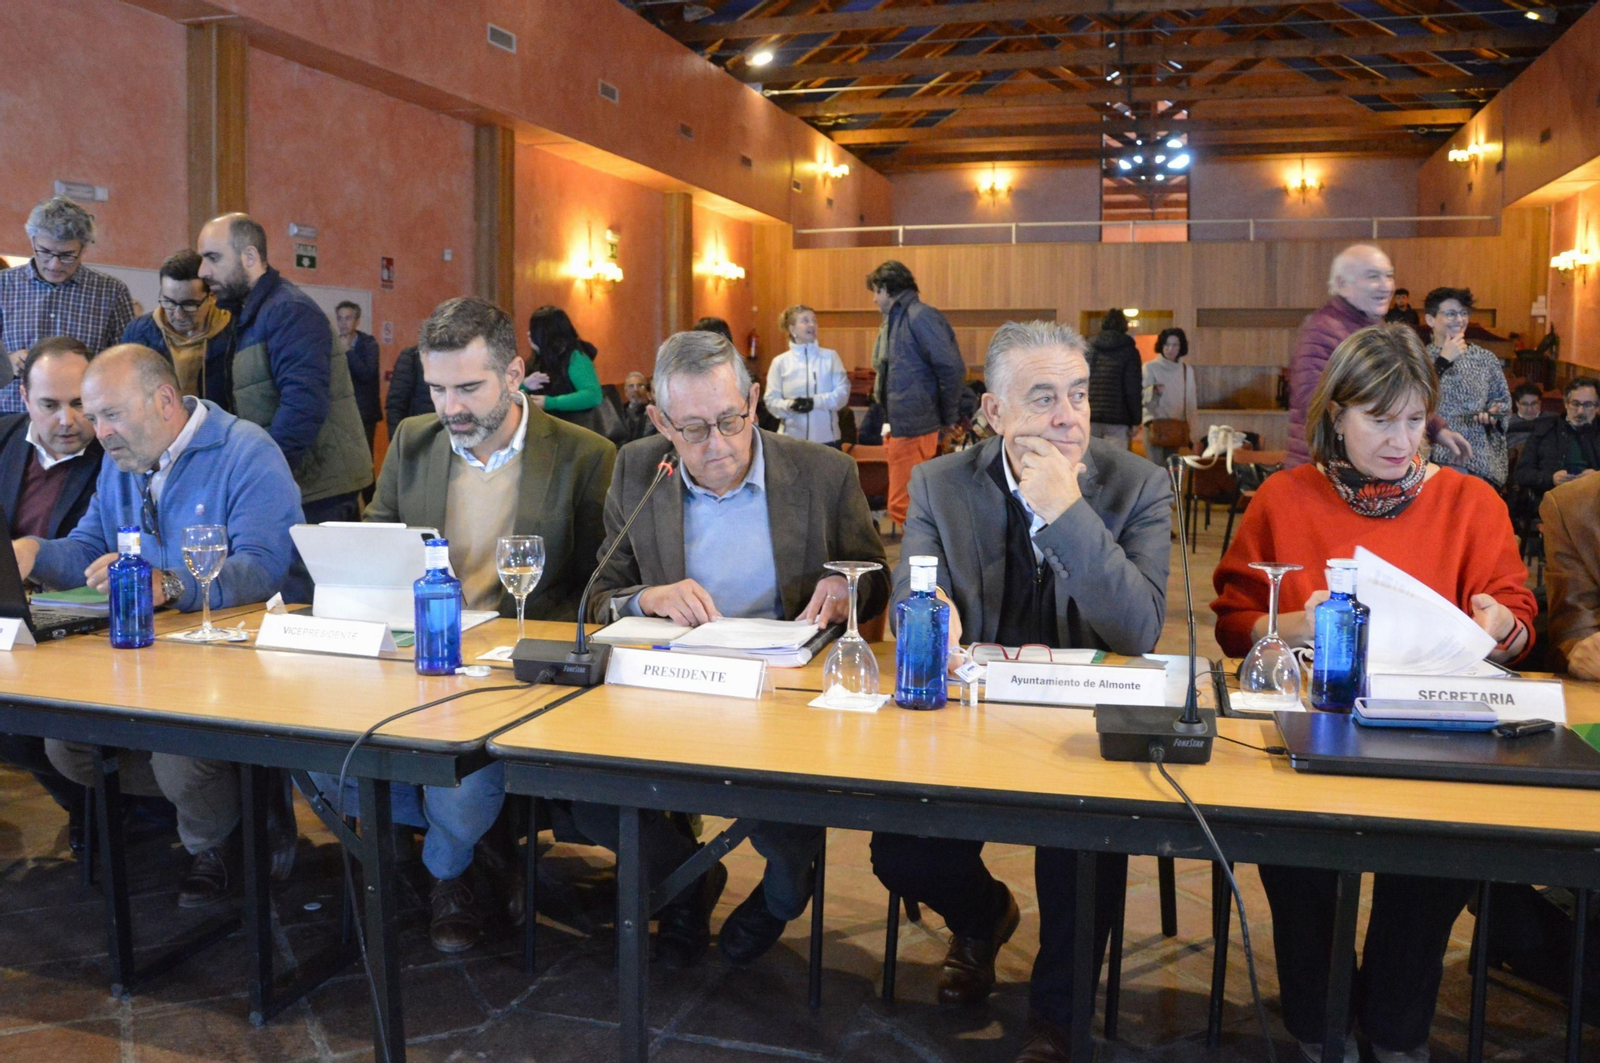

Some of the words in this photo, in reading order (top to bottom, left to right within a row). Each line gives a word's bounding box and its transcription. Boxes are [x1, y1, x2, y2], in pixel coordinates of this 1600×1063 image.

[283, 626, 359, 640] VICEPRESIDENTE
[643, 664, 727, 683] PRESIDENTE
[1011, 675, 1080, 688] Ayuntamiento
[1083, 679, 1096, 688] de
[1098, 679, 1141, 690] Almonte
[1418, 690, 1516, 706] SECRETARIA
